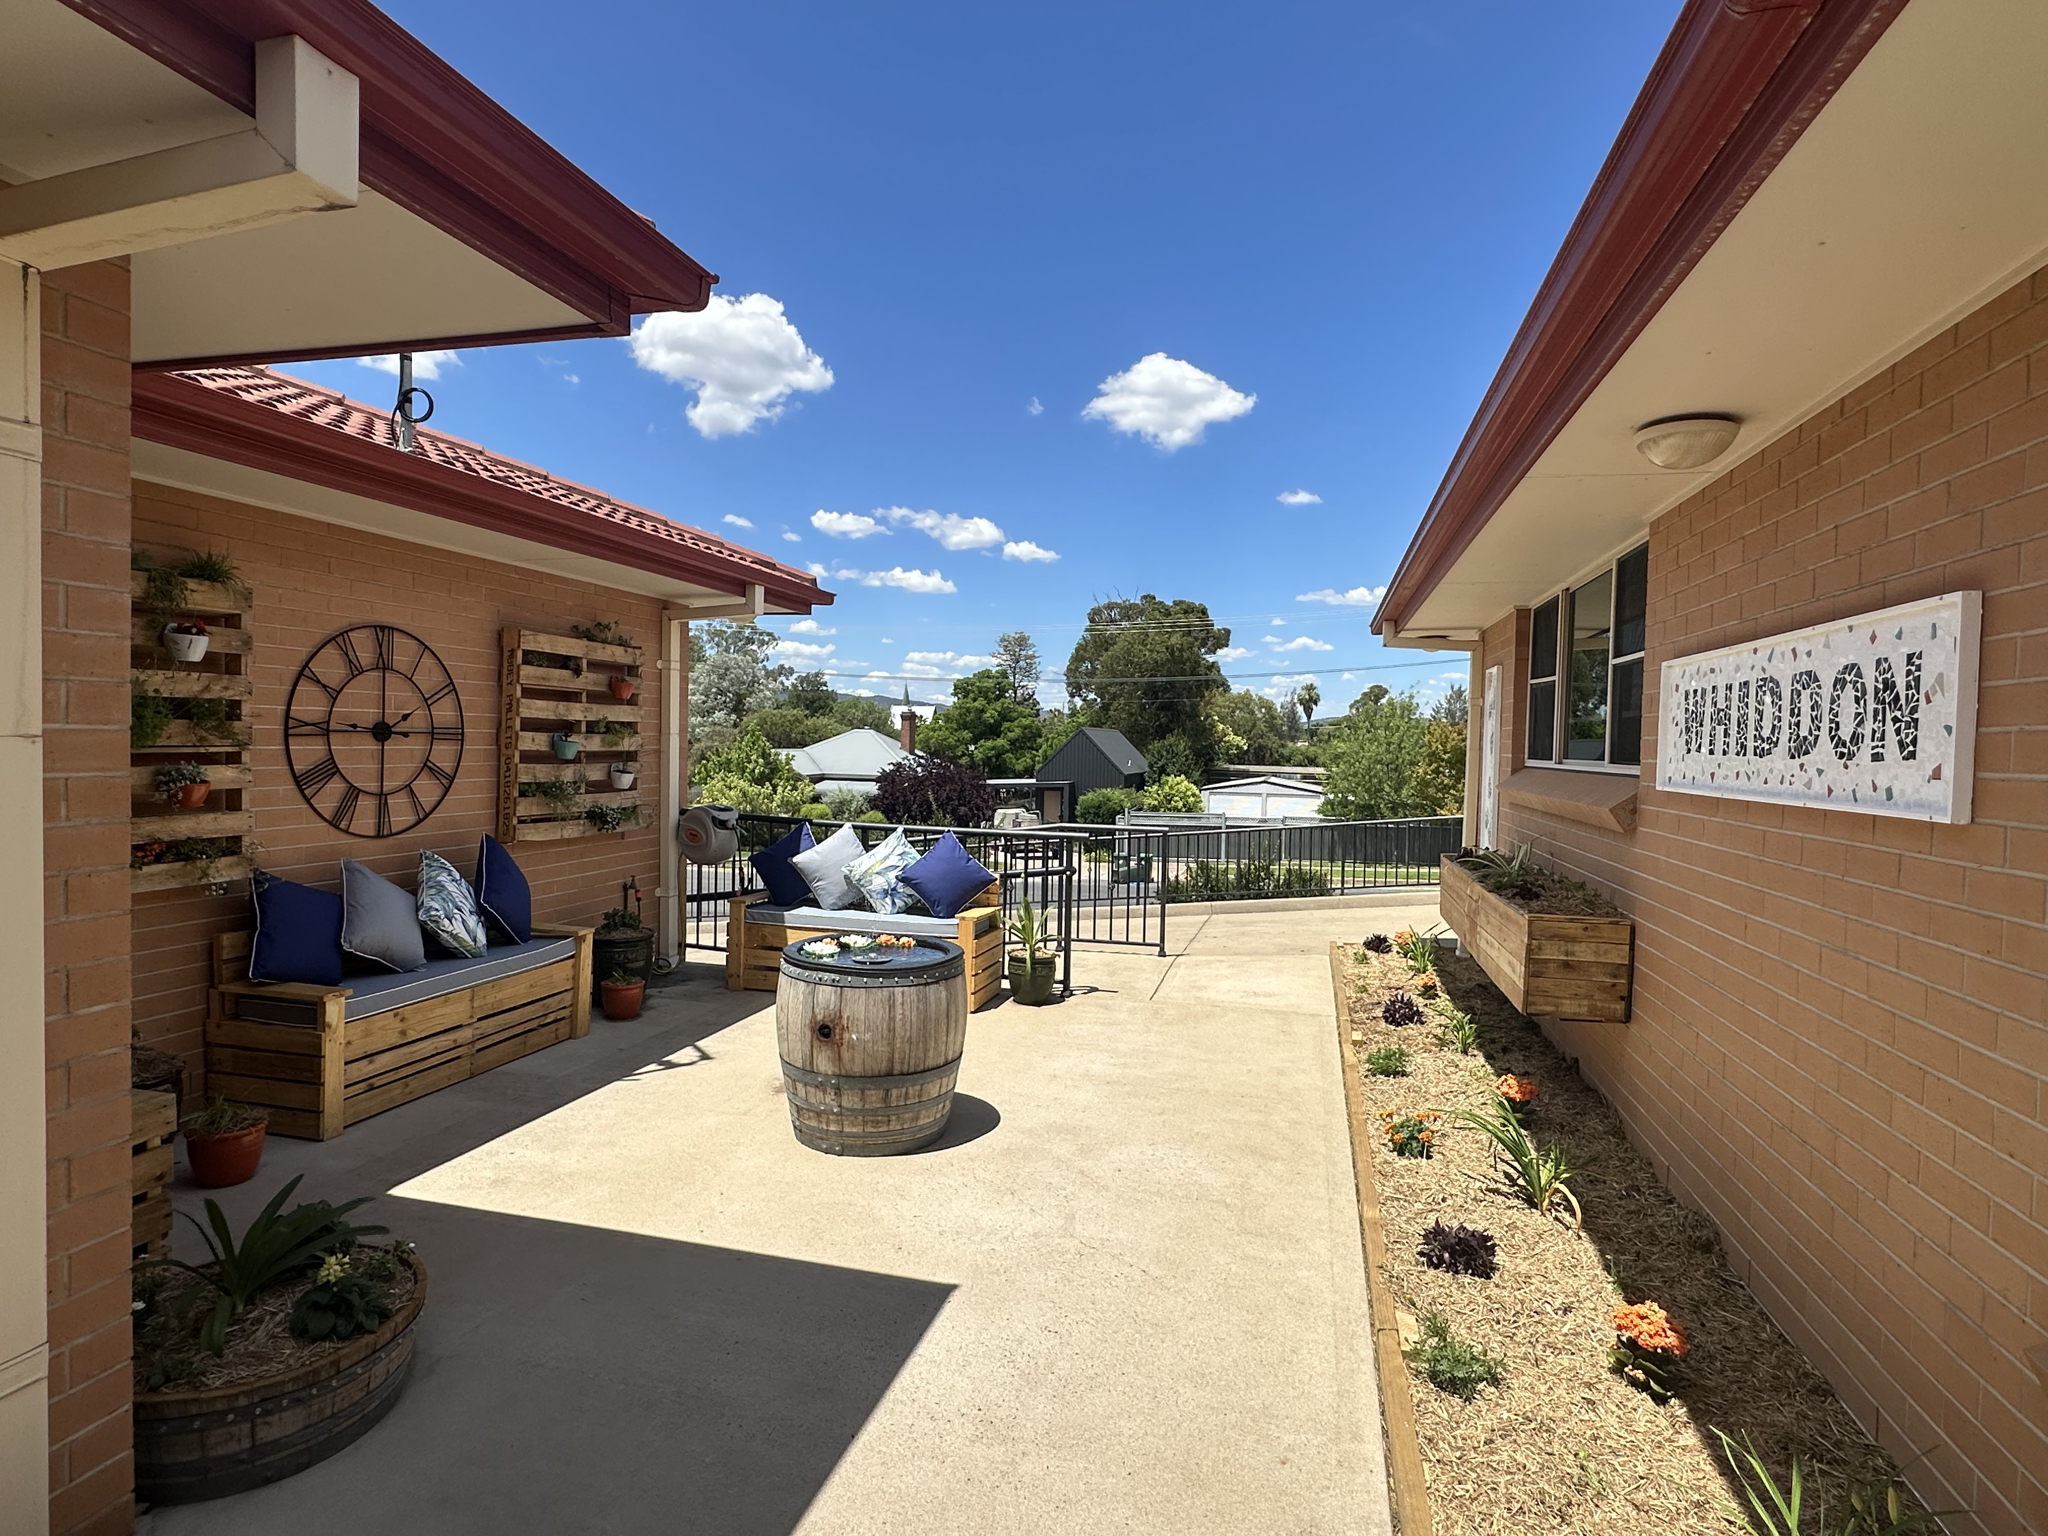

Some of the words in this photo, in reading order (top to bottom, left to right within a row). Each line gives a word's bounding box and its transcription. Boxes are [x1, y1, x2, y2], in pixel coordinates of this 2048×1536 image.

[373, 626, 395, 670] XII
[506, 647, 515, 686] ABBEY
[504, 694, 514, 750] PALLETS
[1684, 650, 1923, 763] WHIDDON
